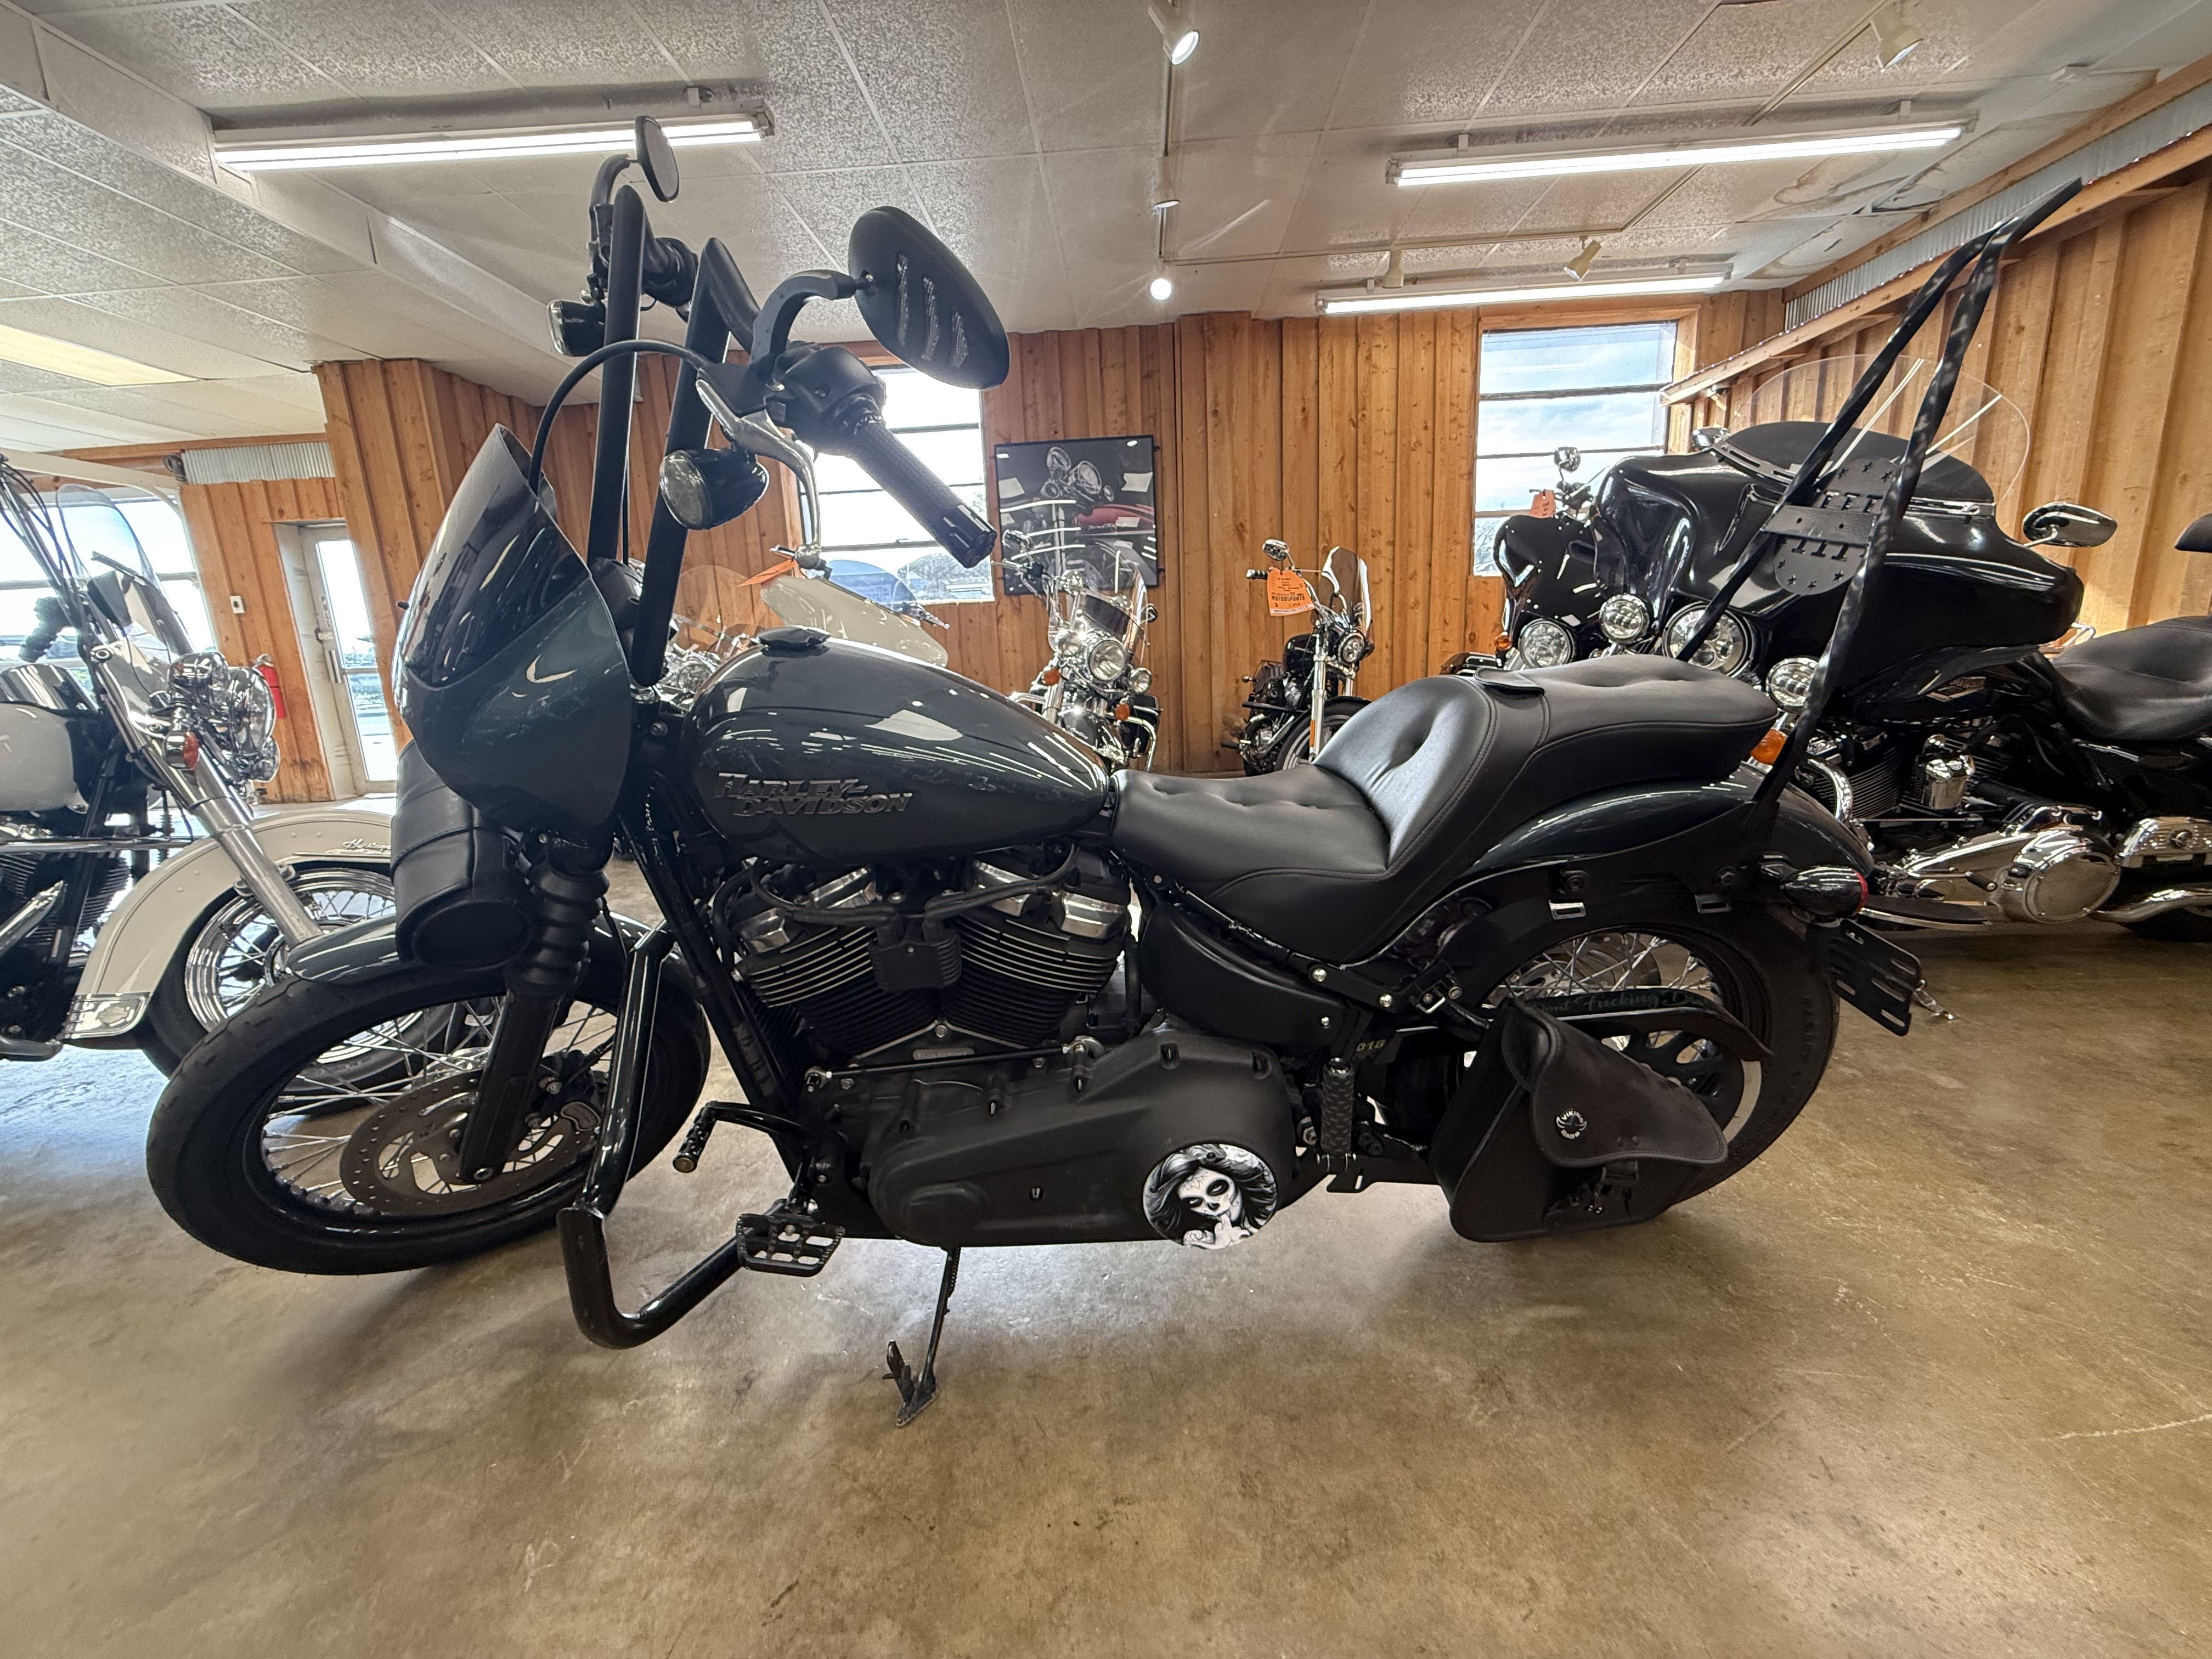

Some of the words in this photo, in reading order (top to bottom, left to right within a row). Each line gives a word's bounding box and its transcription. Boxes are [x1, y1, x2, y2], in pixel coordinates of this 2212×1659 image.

[320, 596, 331, 627] PULL
[715, 772, 868, 798] HARLEY-
[733, 792, 912, 816] DAVIDSON
[1574, 992, 1661, 1012] Fucking
[1561, 1111, 1584, 1123] VIKING
[1561, 1129, 1581, 1139] BAGS
